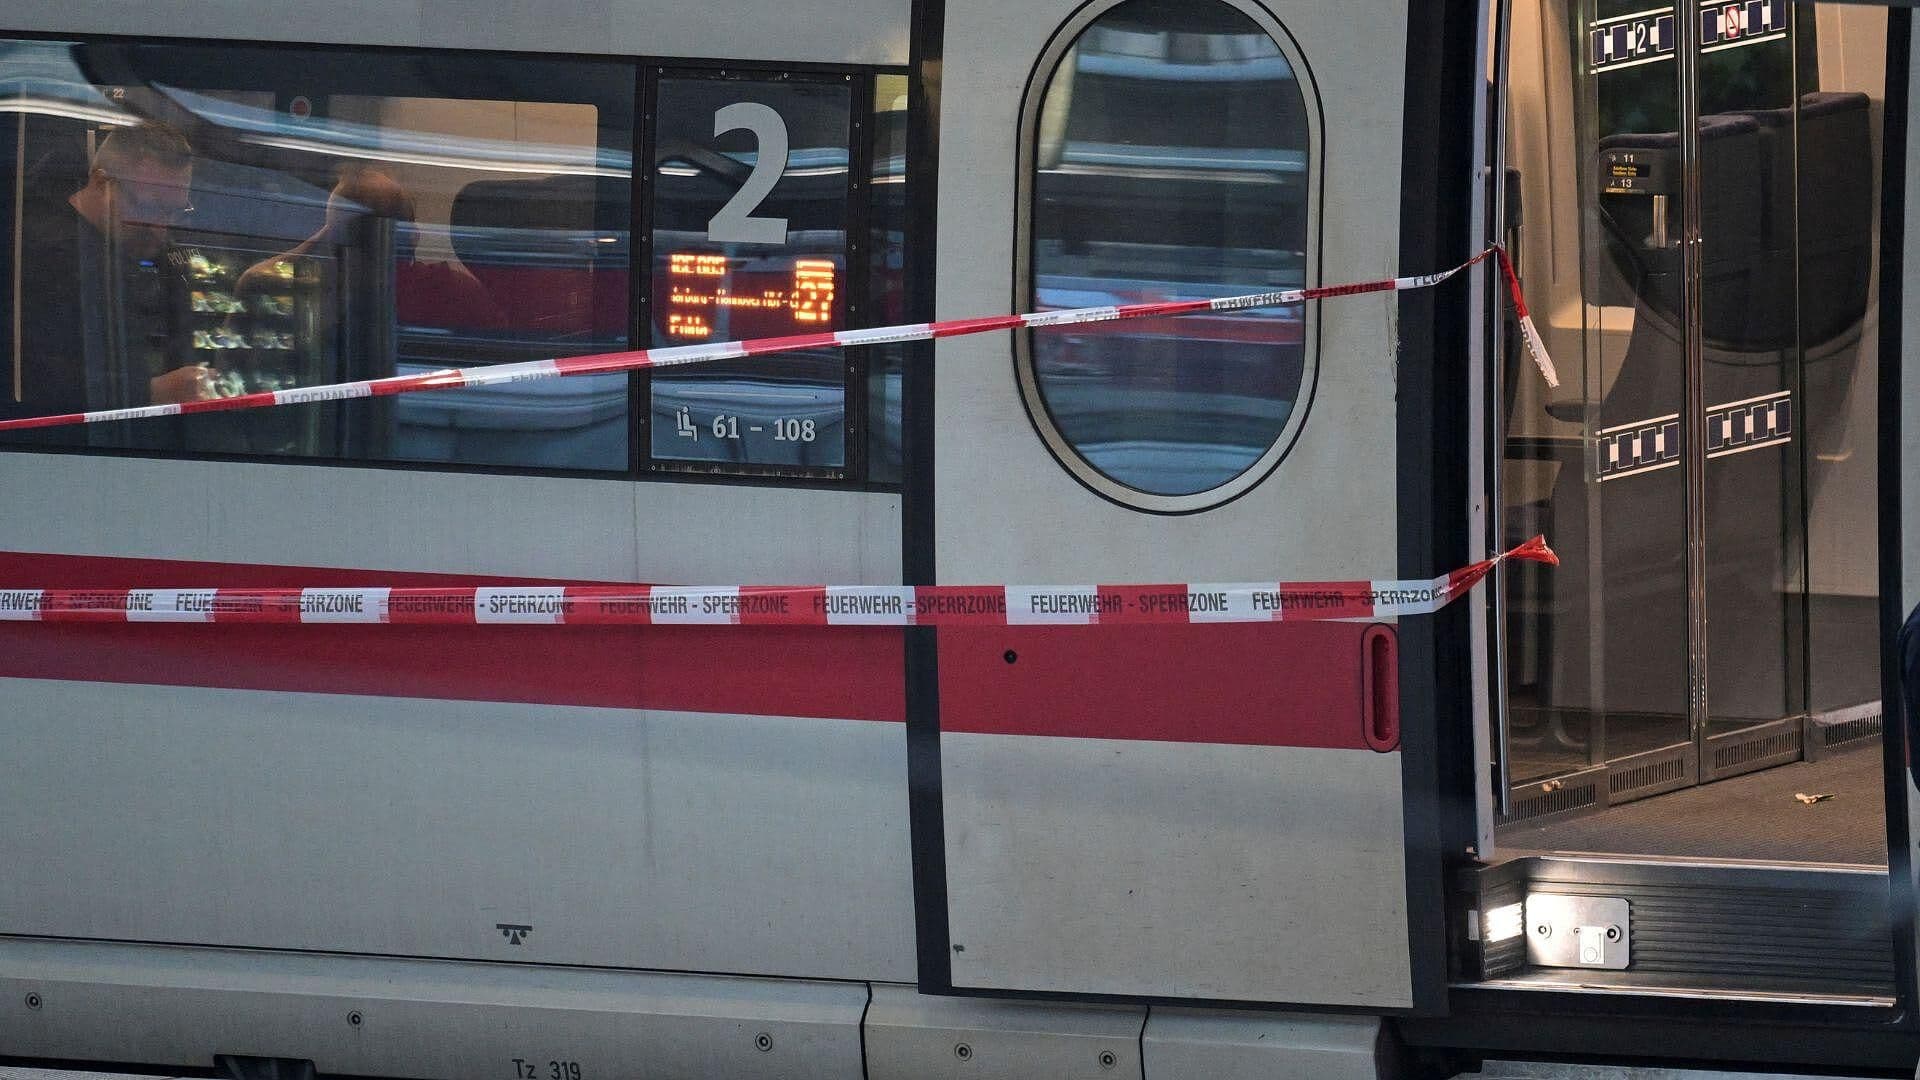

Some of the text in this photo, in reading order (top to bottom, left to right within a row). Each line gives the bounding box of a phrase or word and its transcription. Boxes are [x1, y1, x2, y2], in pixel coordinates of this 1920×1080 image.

[1637, 23, 1647, 54] 2
[707, 102, 789, 245] 2
[712, 415, 740, 438] 61
[774, 419, 816, 442] 108
[280, 593, 363, 613] SPERRZONE
[388, 594, 474, 613] FEUERWEHR
[489, 594, 574, 613] SPERRZONE
[600, 596, 688, 615] FEUERWEHR
[702, 595, 788, 614] SPERRZONE
[813, 595, 902, 615] FEUERWEHR
[917, 595, 1006, 615] SPERRZONE
[1031, 594, 1122, 614] FEUERWEHR
[1139, 593, 1228, 614] SPERRZONE
[1252, 592, 1345, 612] FEUERWEHR
[511, 1059, 581, 1080] Tz 319
